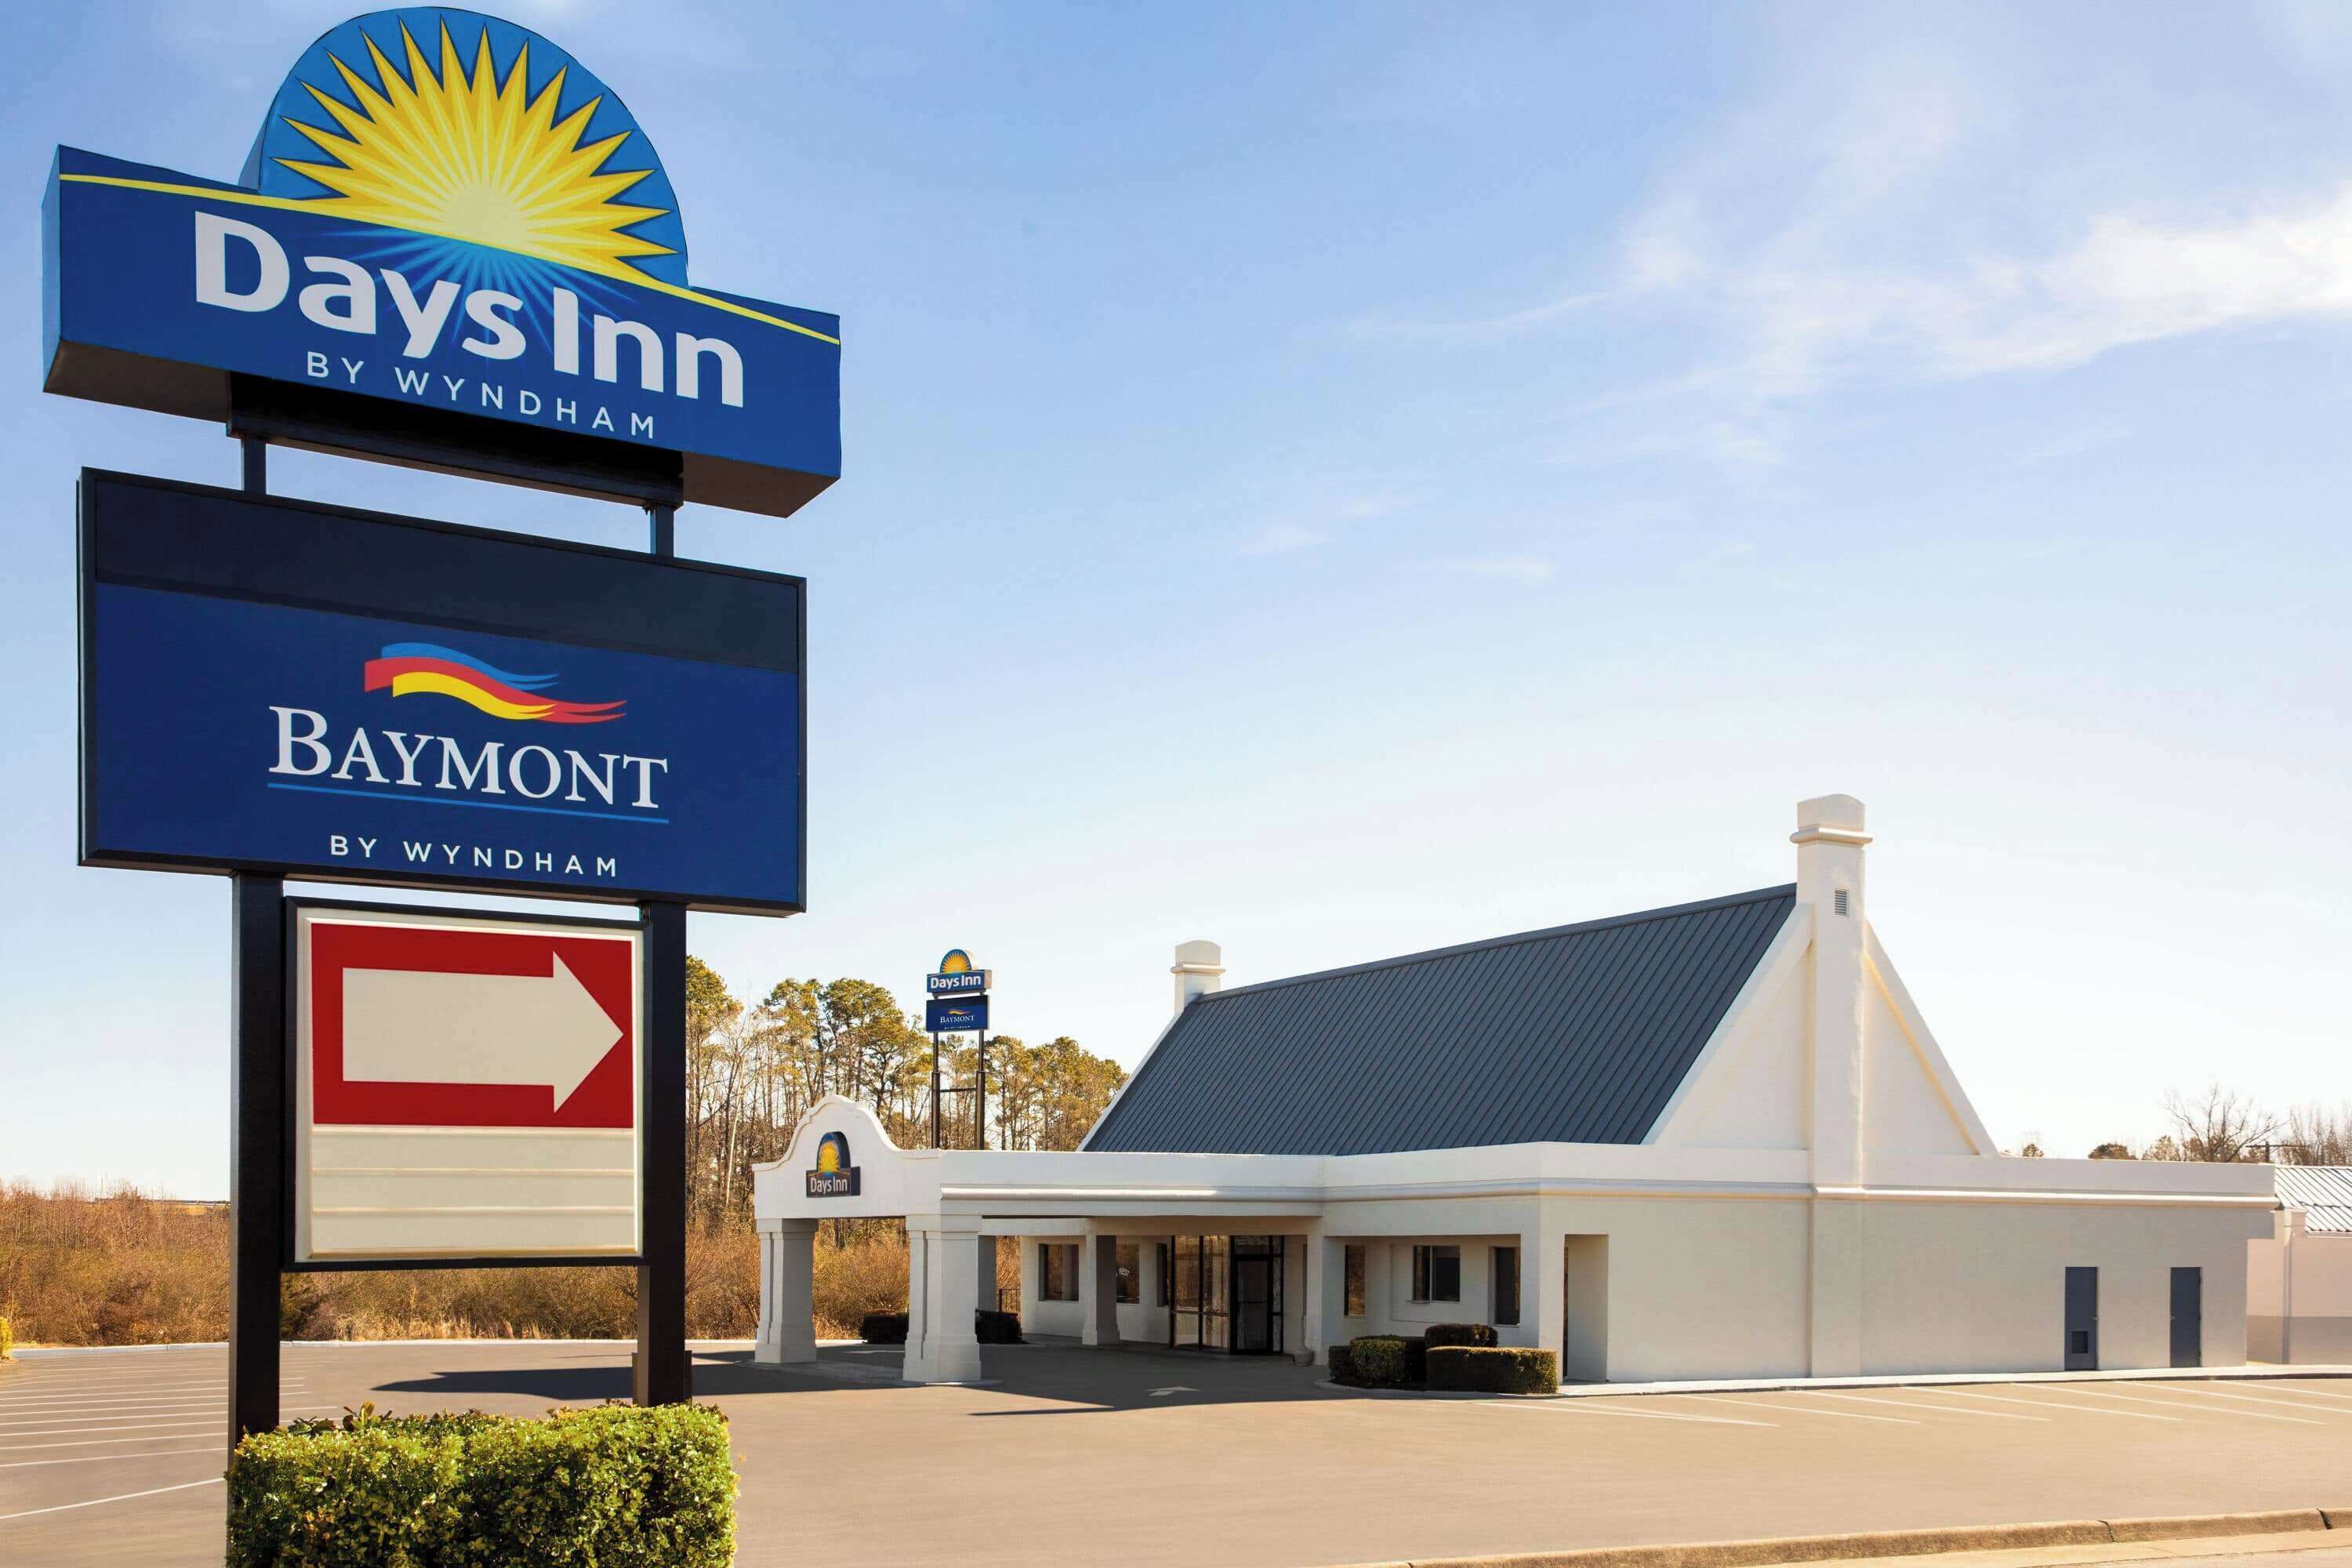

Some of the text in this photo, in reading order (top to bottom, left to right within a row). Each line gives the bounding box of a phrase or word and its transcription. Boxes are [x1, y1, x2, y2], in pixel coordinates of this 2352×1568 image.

[195, 211, 744, 408] Days Inn
[307, 351, 655, 439] BY WYNDHAM
[269, 706, 668, 808] BAYMONT
[330, 835, 617, 877] BY WYNDHAM
[930, 975, 982, 989] Days Inn
[940, 1014, 975, 1023] BAYMONT
[810, 1176, 848, 1195] Days Inn
